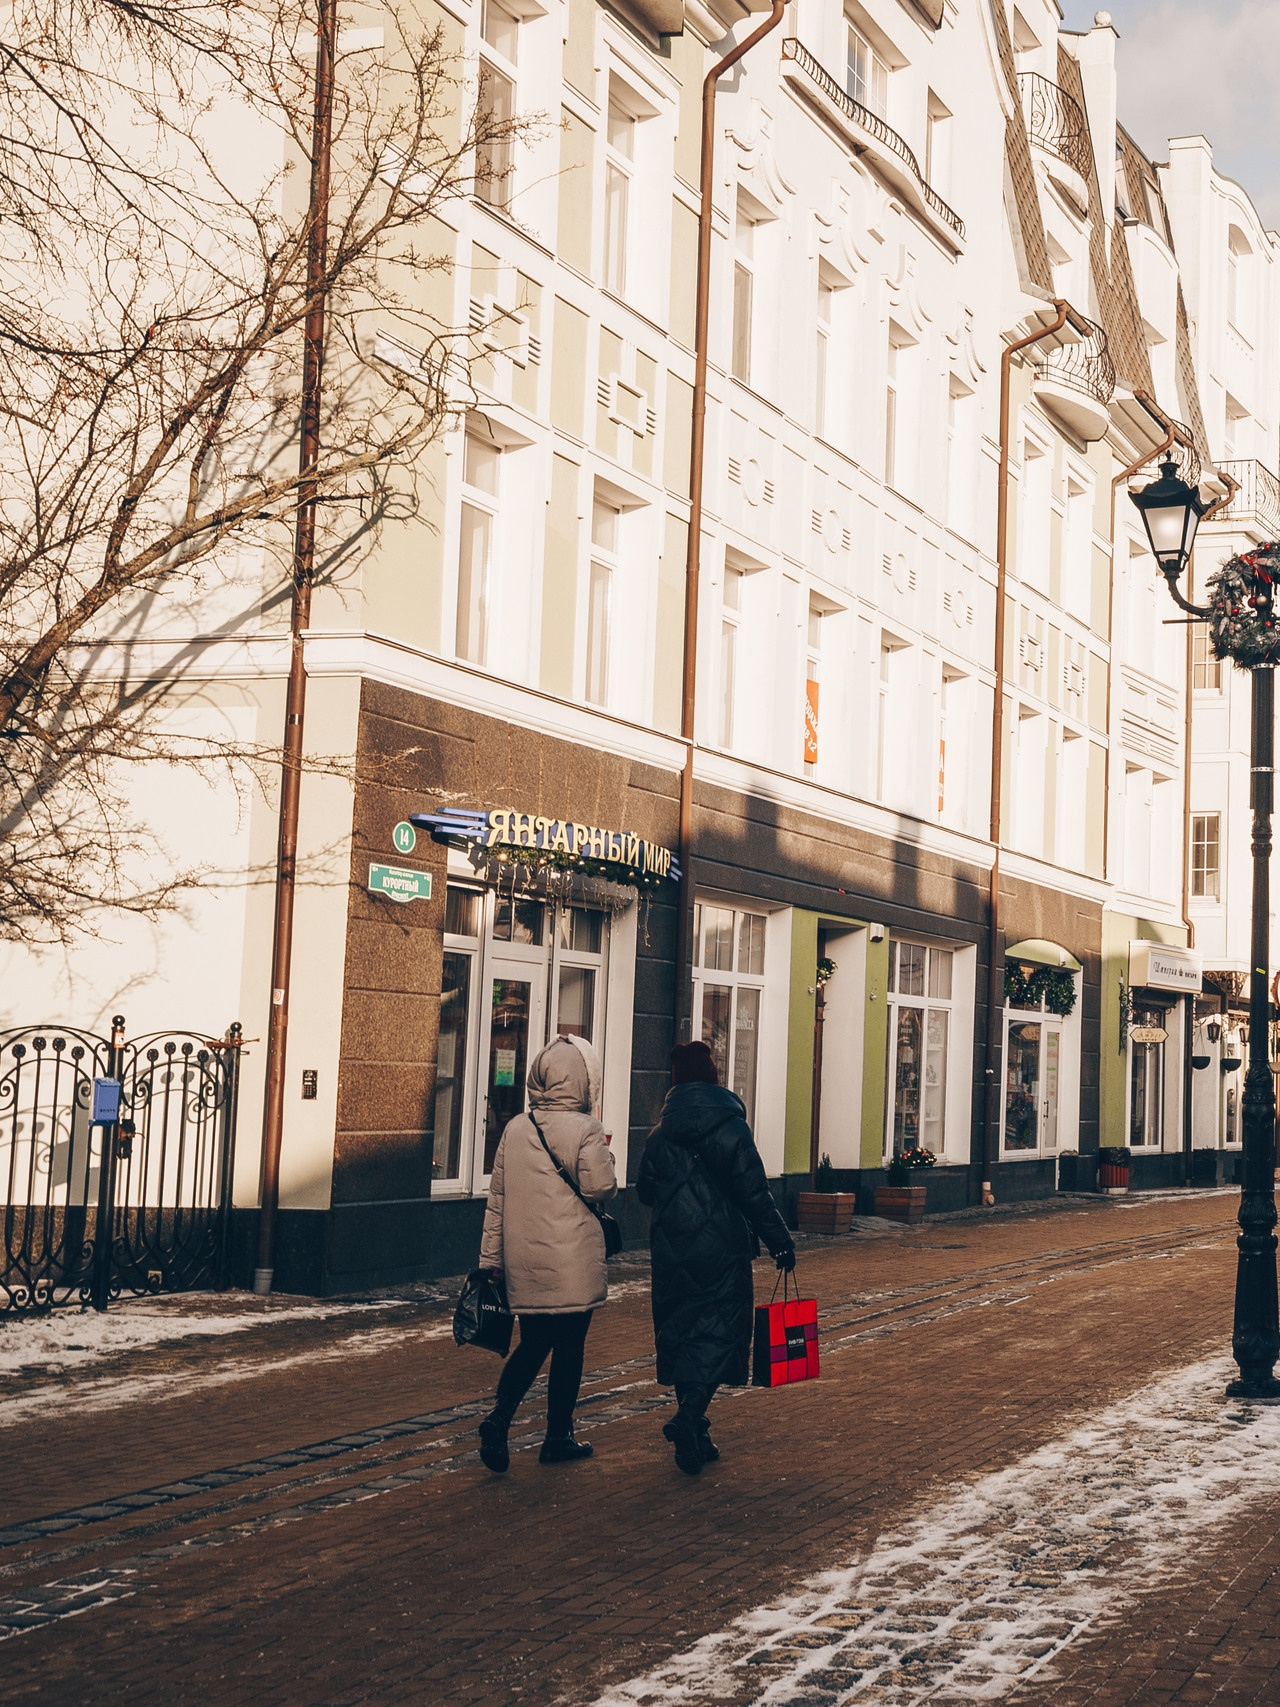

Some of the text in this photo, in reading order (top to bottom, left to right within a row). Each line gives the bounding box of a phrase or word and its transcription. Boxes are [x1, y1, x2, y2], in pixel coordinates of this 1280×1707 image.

[400, 828, 410, 846] 14
[486, 809, 671, 878] ЯНТАРНЫЙ МИР
[382, 876, 419, 893] КУРОРТНЫЙ
